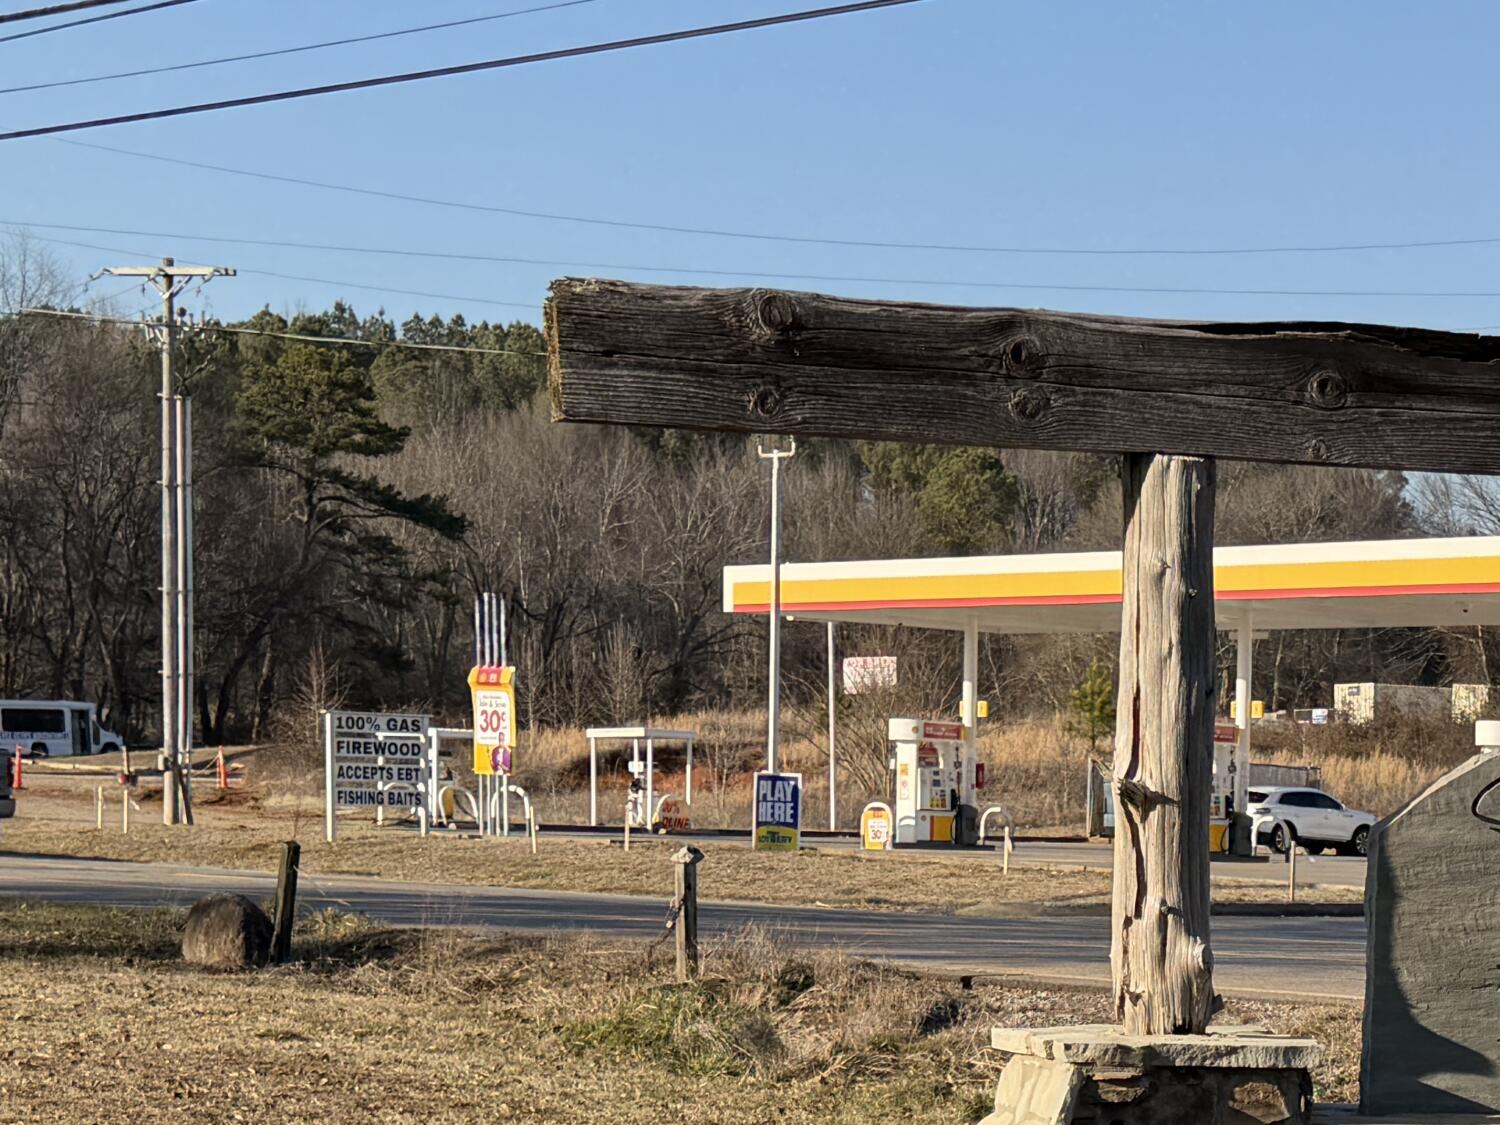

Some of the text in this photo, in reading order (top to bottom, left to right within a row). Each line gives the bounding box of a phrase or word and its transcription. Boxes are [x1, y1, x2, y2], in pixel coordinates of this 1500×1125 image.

[336, 716, 420, 732] 100% GAS
[336, 740, 421, 756] FIREWOOD
[337, 765, 420, 780] ACCEPTS EBT
[337, 790, 422, 805] FISHING BAITS
[758, 780, 795, 801] PLAY
[758, 801, 794, 823] HERE
